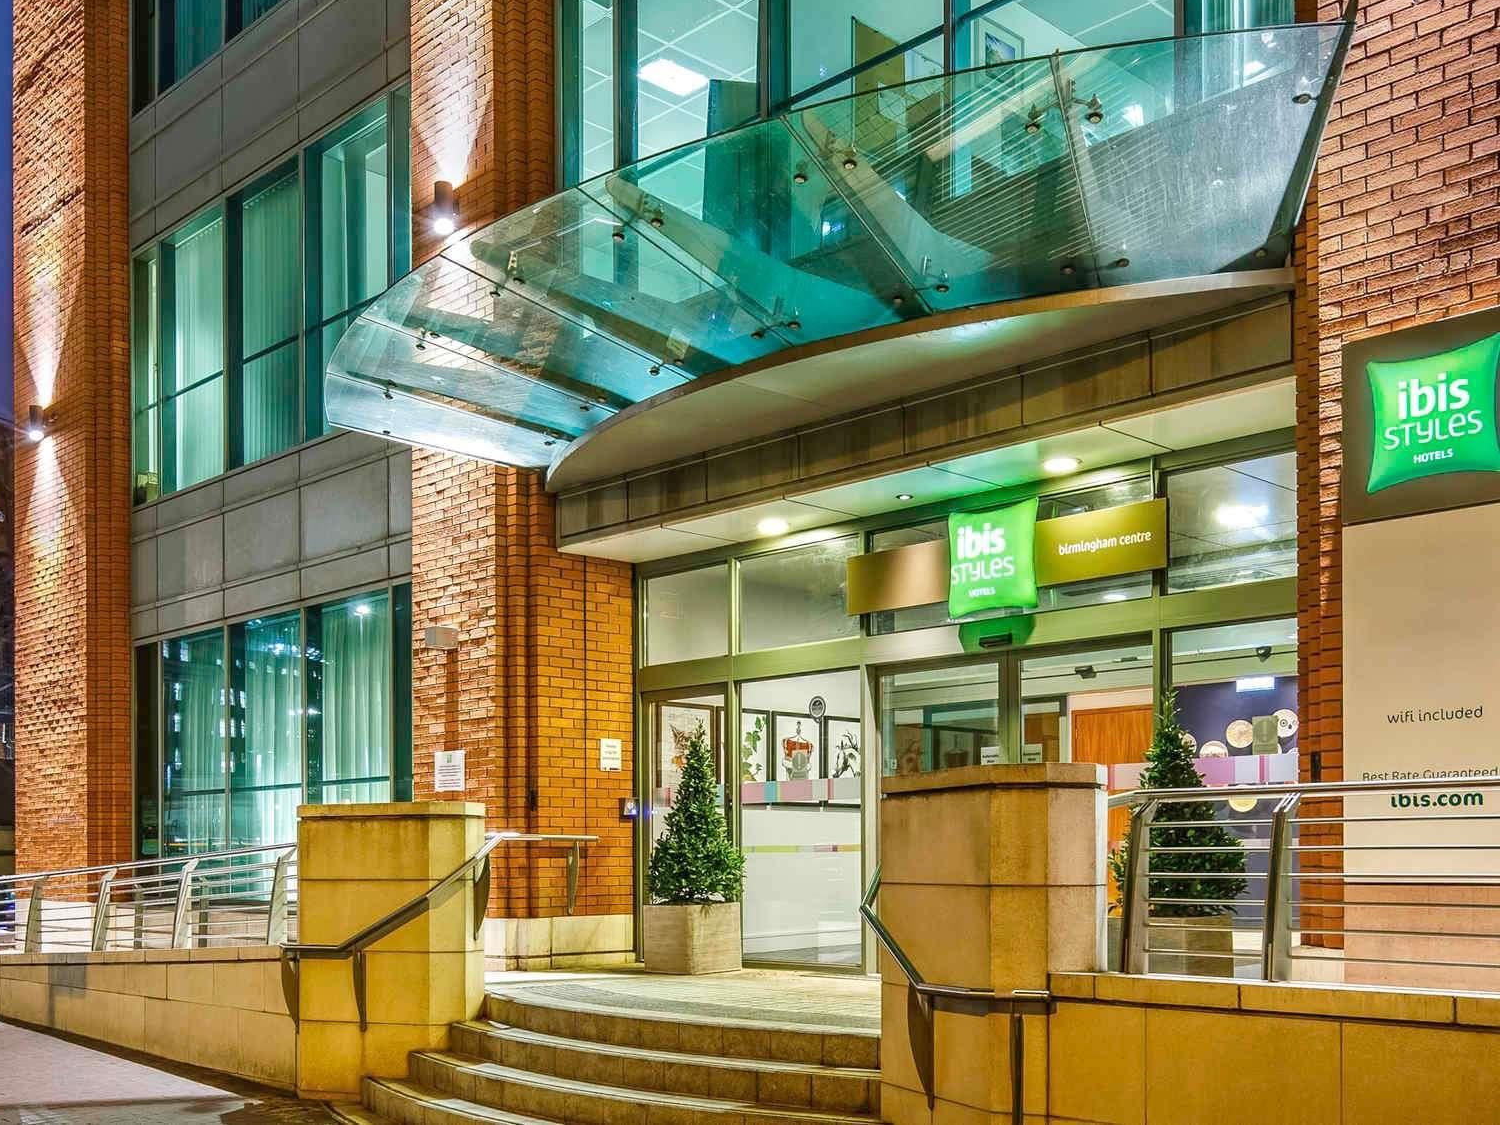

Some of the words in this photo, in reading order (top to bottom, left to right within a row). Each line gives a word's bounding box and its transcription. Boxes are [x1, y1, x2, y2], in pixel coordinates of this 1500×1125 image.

[1398, 372, 1470, 420] ibis
[1412, 448, 1454, 464] HOTELS
[957, 522, 1006, 560] ibis
[1058, 536, 1118, 556] birmingham
[1119, 531, 1152, 546] centre
[1387, 709, 1414, 724] wifi
[1418, 705, 1483, 722] included
[1390, 792, 1484, 808] ibis.com
